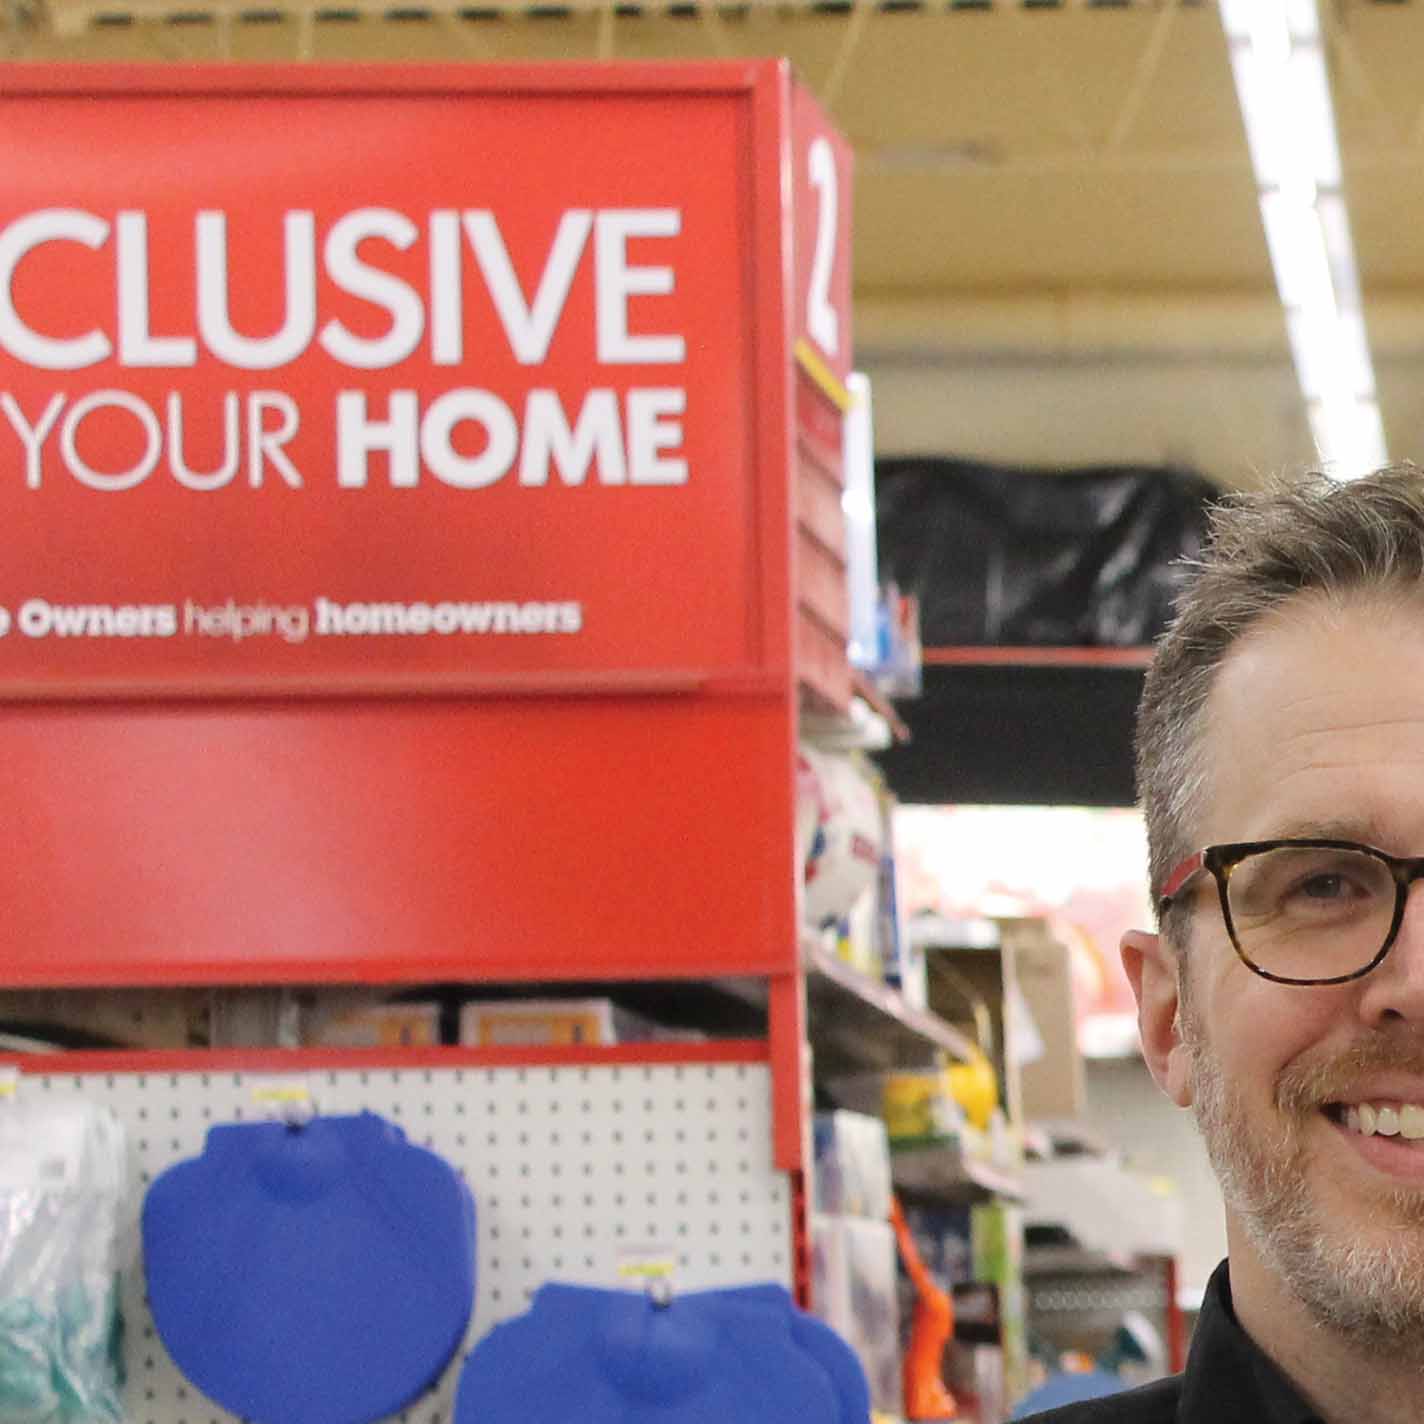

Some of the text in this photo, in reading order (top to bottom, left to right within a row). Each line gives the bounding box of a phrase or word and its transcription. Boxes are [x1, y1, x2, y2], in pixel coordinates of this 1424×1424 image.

[0, 207, 685, 370] CLUSIVE
[807, 138, 838, 357] 2
[0, 388, 689, 491] YOUR HOME
[17, 598, 177, 637] Owners
[183, 598, 309, 642] helping
[315, 596, 583, 635] homeowners
